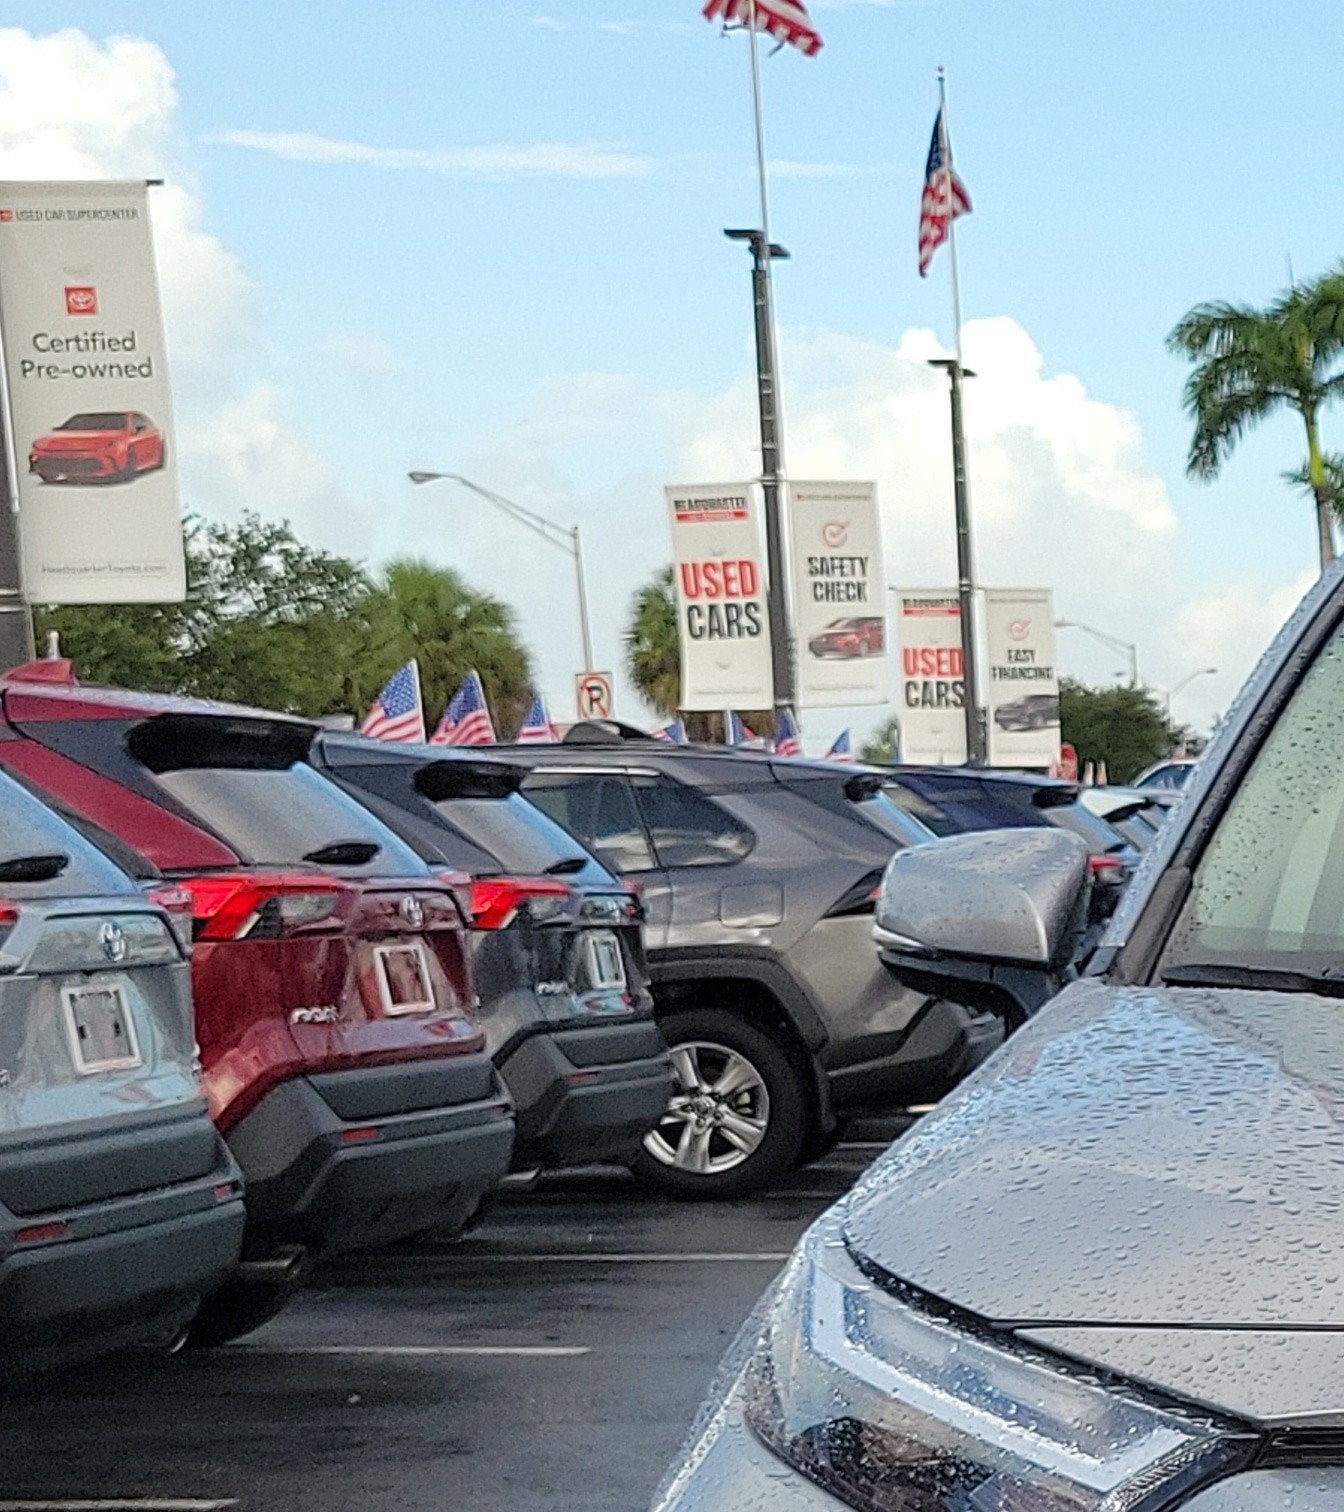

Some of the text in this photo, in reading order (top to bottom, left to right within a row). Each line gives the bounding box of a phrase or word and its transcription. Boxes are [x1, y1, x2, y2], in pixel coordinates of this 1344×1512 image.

[16, 209, 43, 221] USED
[32, 330, 137, 353] Certified
[20, 356, 153, 379] Pre-owned
[807, 556, 869, 577] SAFETY
[680, 560, 758, 598] USED
[813, 581, 867, 602] CHECK
[687, 602, 761, 640] CARS
[902, 647, 964, 677] USED
[905, 680, 966, 709] CARS
